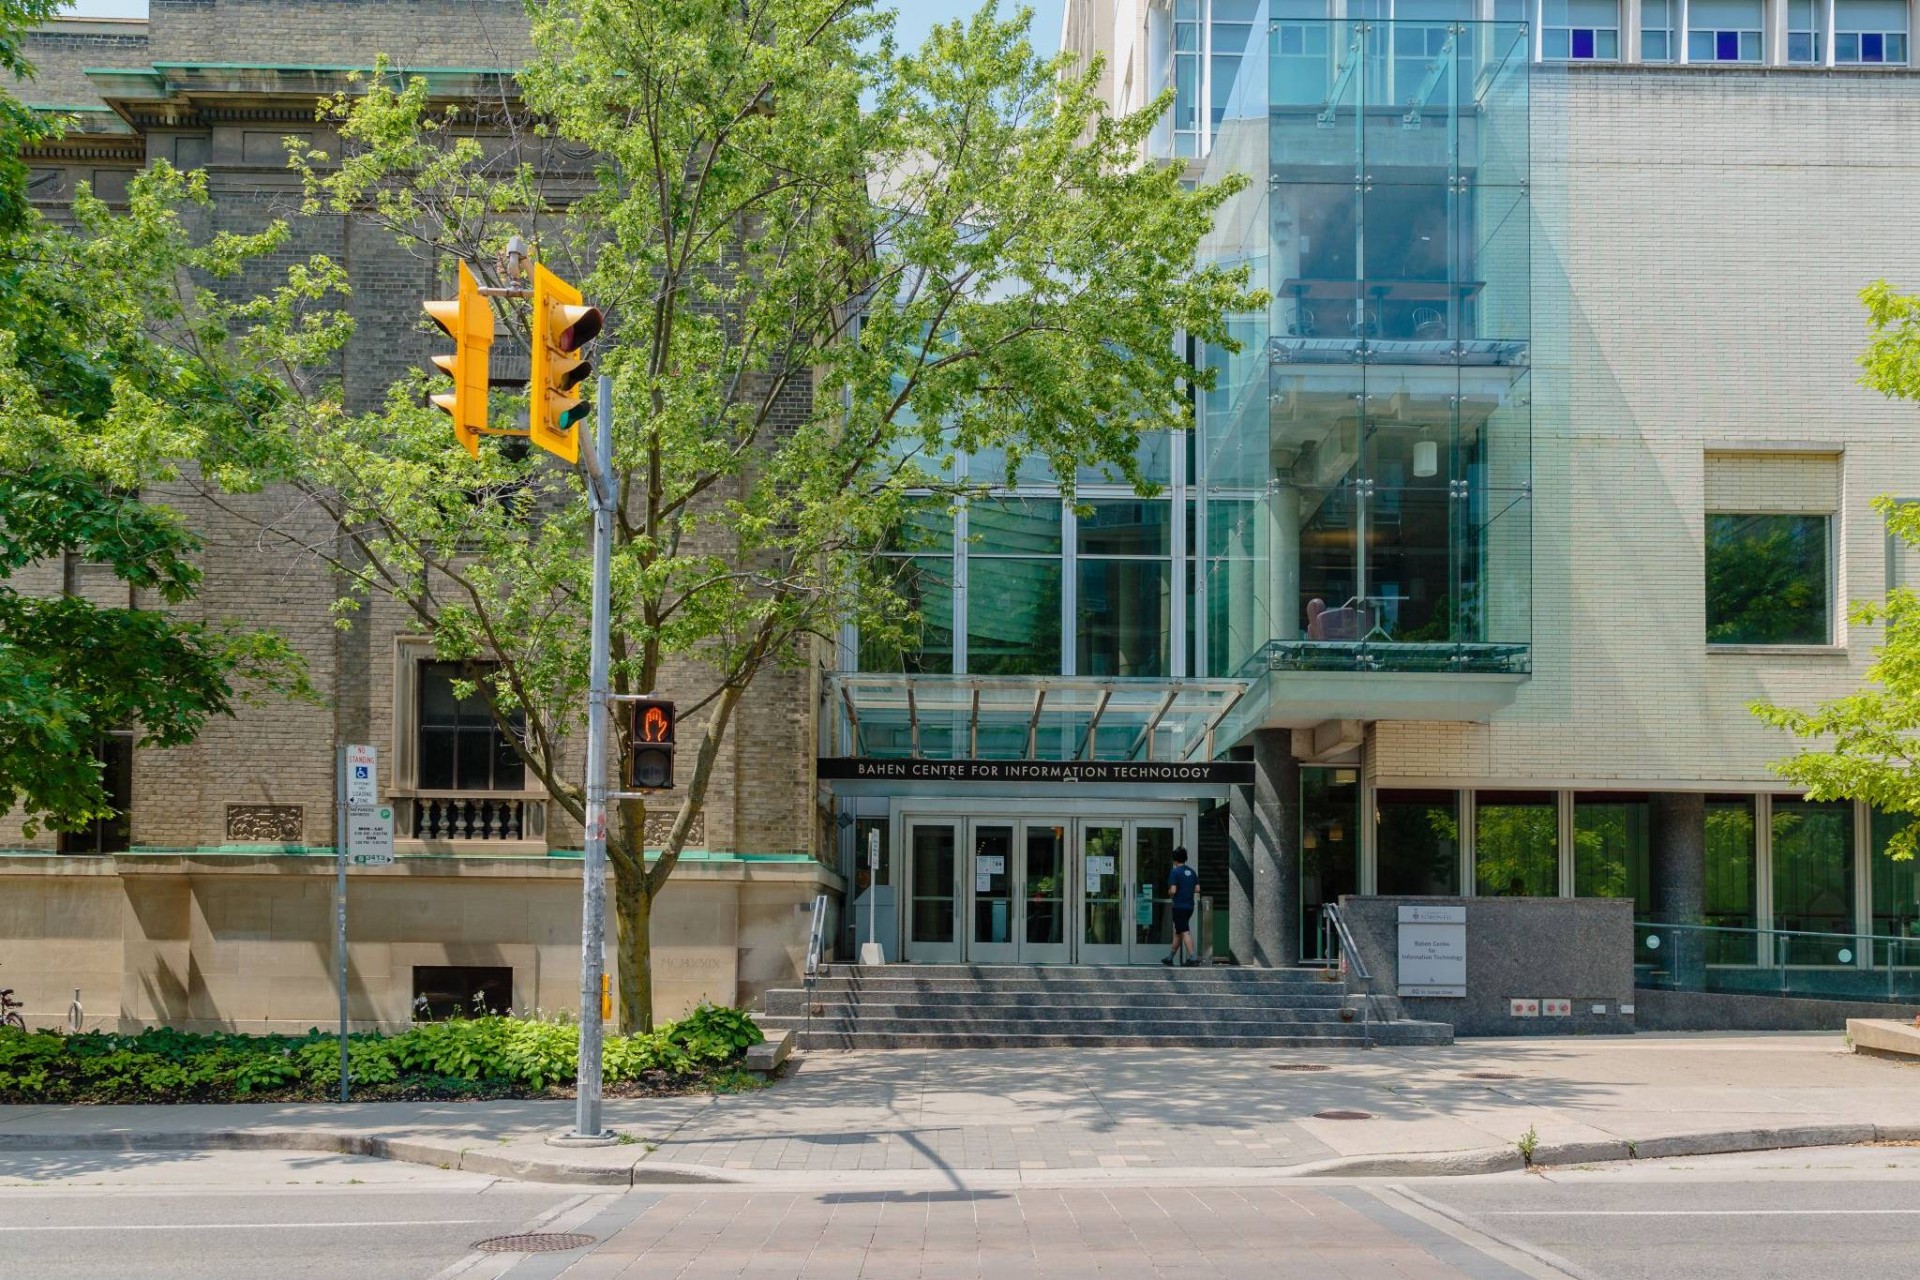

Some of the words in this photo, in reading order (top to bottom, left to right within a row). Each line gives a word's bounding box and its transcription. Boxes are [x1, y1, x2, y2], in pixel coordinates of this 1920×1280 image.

[357, 745, 366, 755] NO
[348, 755, 375, 765] STANDING
[857, 763, 906, 775] BAHEN
[912, 764, 965, 776] CENTRE
[971, 765, 999, 777] FOR
[1005, 765, 1108, 778] INFORMATION
[1113, 766, 1211, 779] TECHNOLOGY
[1433, 953, 1463, 962] Technology
